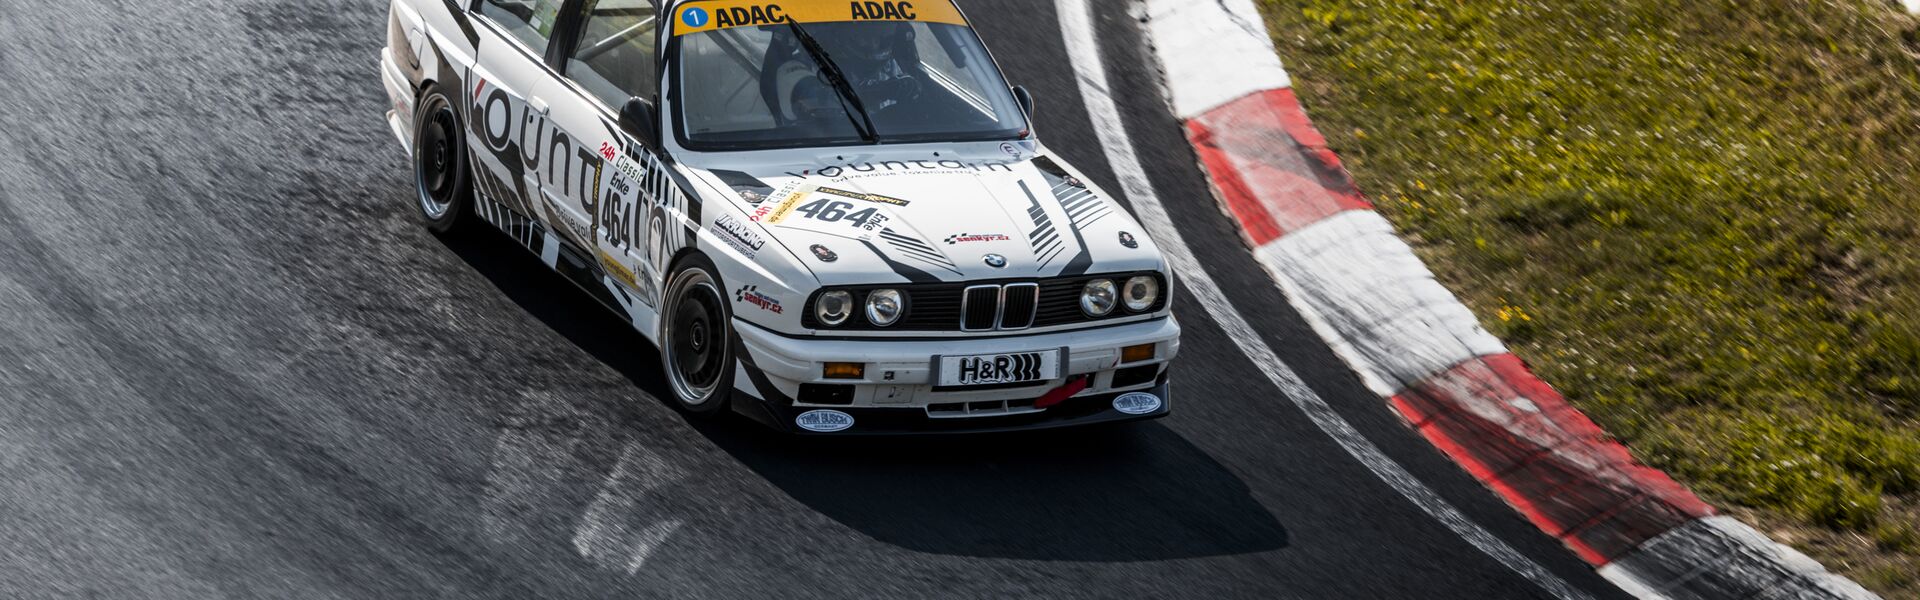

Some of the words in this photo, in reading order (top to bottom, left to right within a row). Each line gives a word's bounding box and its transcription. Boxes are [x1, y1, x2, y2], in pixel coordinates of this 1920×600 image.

[689, 9, 700, 26] 1
[716, 4, 785, 28] ADAC
[850, 1, 917, 20] ADAC
[600, 142, 616, 163] 24h
[615, 155, 644, 184] Classic
[610, 172, 630, 195] Enke
[602, 188, 632, 257] 464
[749, 206, 773, 222] 24h
[796, 197, 878, 228] 464
[863, 212, 889, 232] Enke
[955, 235, 1008, 243] senkyr.cz
[744, 292, 784, 315] senkyr.cz
[960, 356, 1014, 384] H&R
